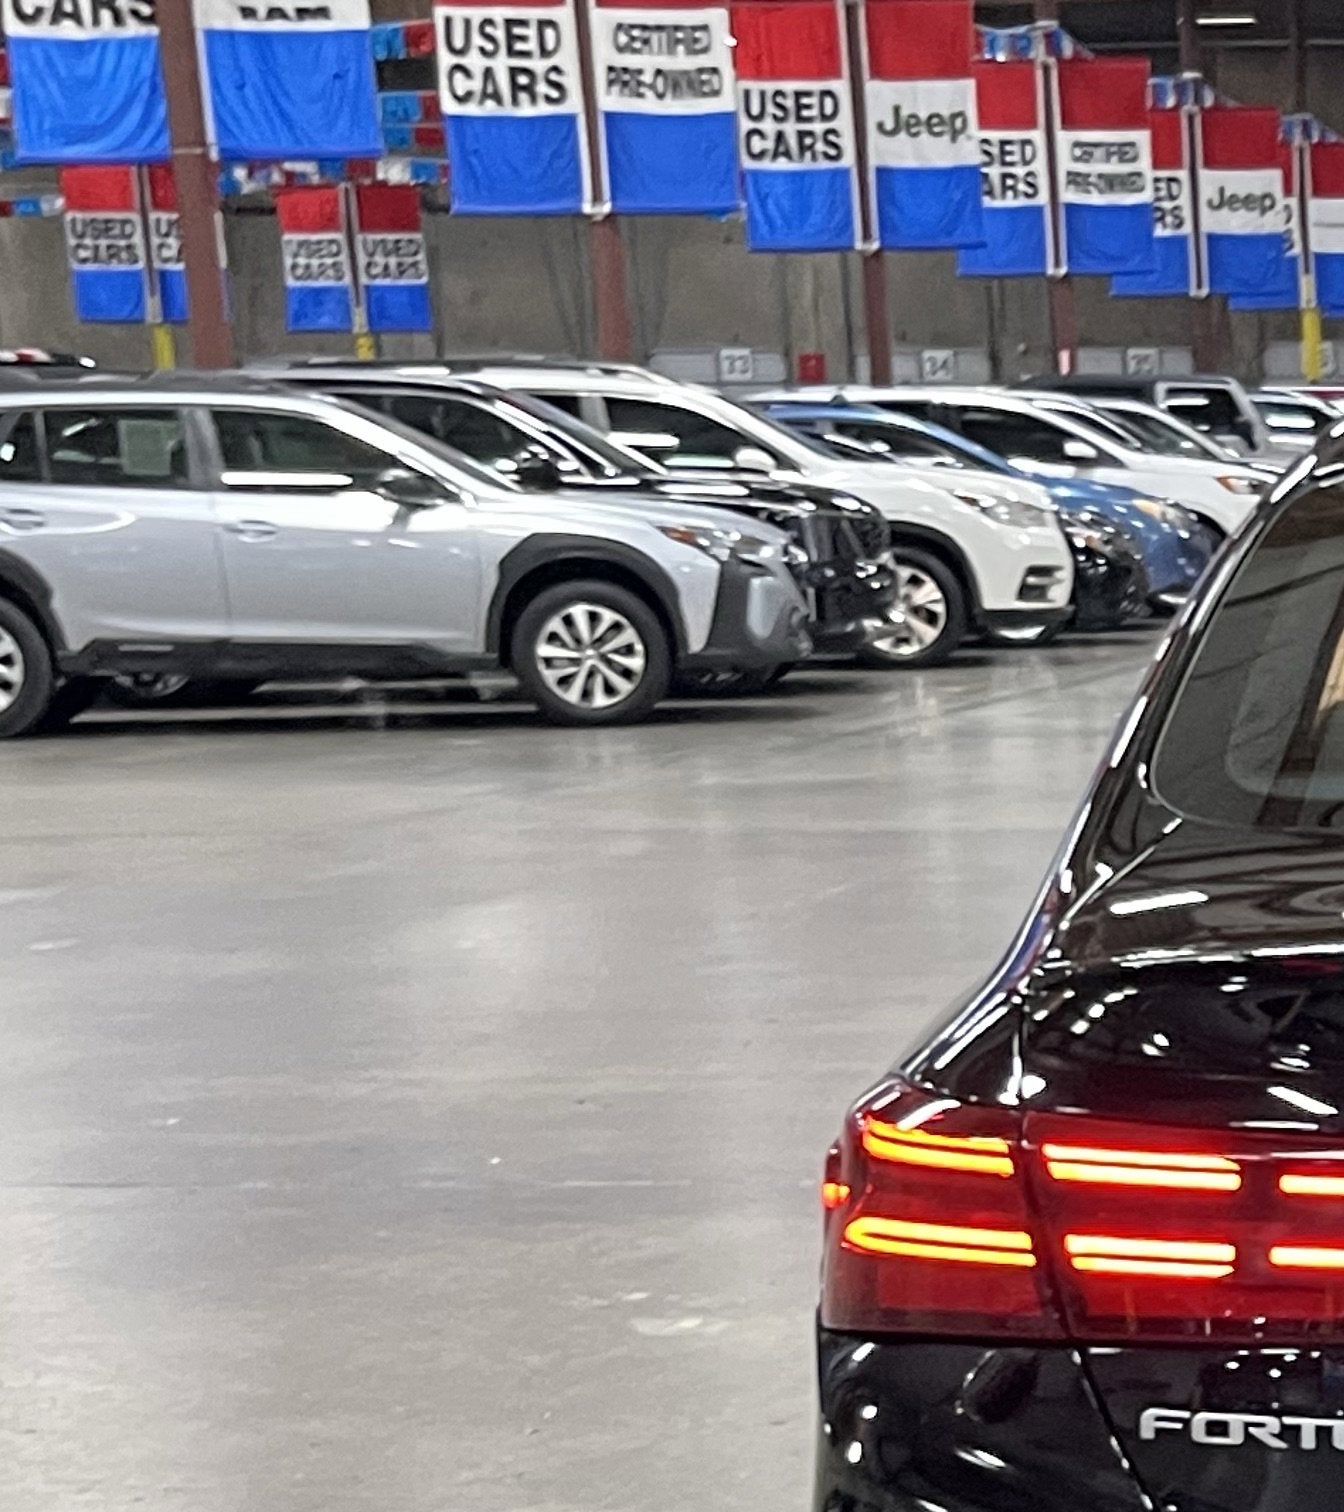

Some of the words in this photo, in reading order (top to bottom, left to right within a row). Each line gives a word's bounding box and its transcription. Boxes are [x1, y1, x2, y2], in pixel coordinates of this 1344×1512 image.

[444, 16, 562, 59] USED
[613, 22, 712, 56] CERTIFIED
[448, 63, 567, 107] CARS
[606, 65, 723, 100] PRE-OWNED
[743, 89, 840, 123] USED
[876, 104, 969, 144] Jeep
[745, 128, 843, 162] CARS
[979, 138, 1037, 167] SED
[981, 171, 1038, 200] ARS
[1153, 176, 1182, 202] ED
[1206, 186, 1277, 217] Jeep
[70, 217, 137, 240] USED
[72, 243, 140, 265] CARS
